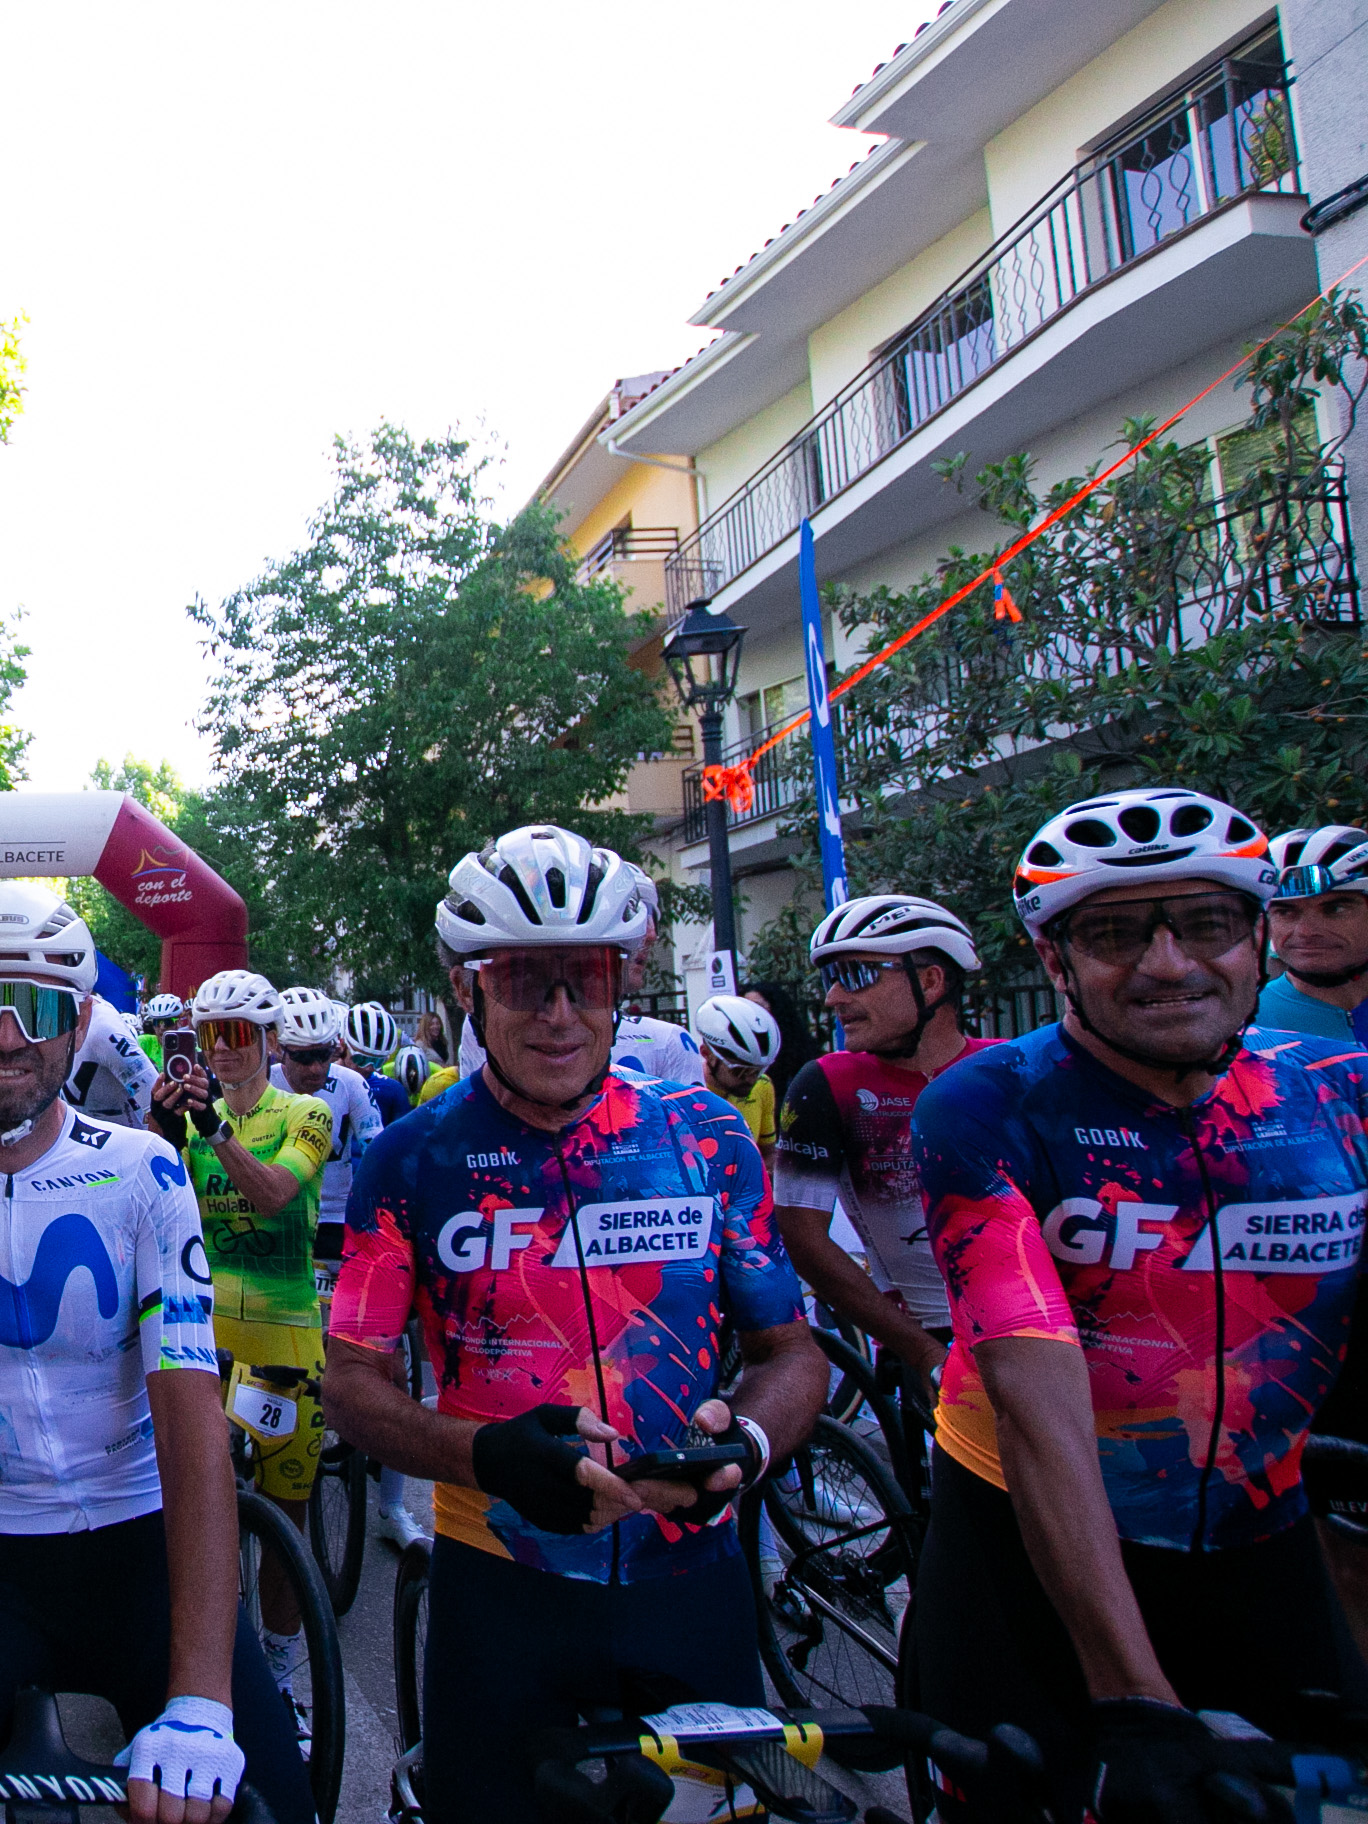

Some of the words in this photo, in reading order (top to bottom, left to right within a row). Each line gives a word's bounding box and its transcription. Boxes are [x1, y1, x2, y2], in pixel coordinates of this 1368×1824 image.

[1128, 843, 1169, 855] catlike
[137, 880, 164, 892] con
[171, 873, 186, 889] el
[135, 889, 192, 907] deporte
[880, 1097, 912, 1107] JASE
[252, 1133, 276, 1143] QUETZAL
[300, 1128, 326, 1153] RACC
[1074, 1128, 1146, 1149] GOBIK
[467, 1151, 519, 1169] GOBIK
[31, 1169, 116, 1191] CANYON
[598, 1211, 673, 1231] SIERRA
[679, 1207, 702, 1225] de
[1245, 1211, 1344, 1235] SIERRA
[586, 1232, 699, 1257] ALBACETE
[1223, 1235, 1361, 1263] ALBACETE
[488, 1338, 562, 1349] INTERNACIONAL
[260, 1403, 282, 1429] 28
